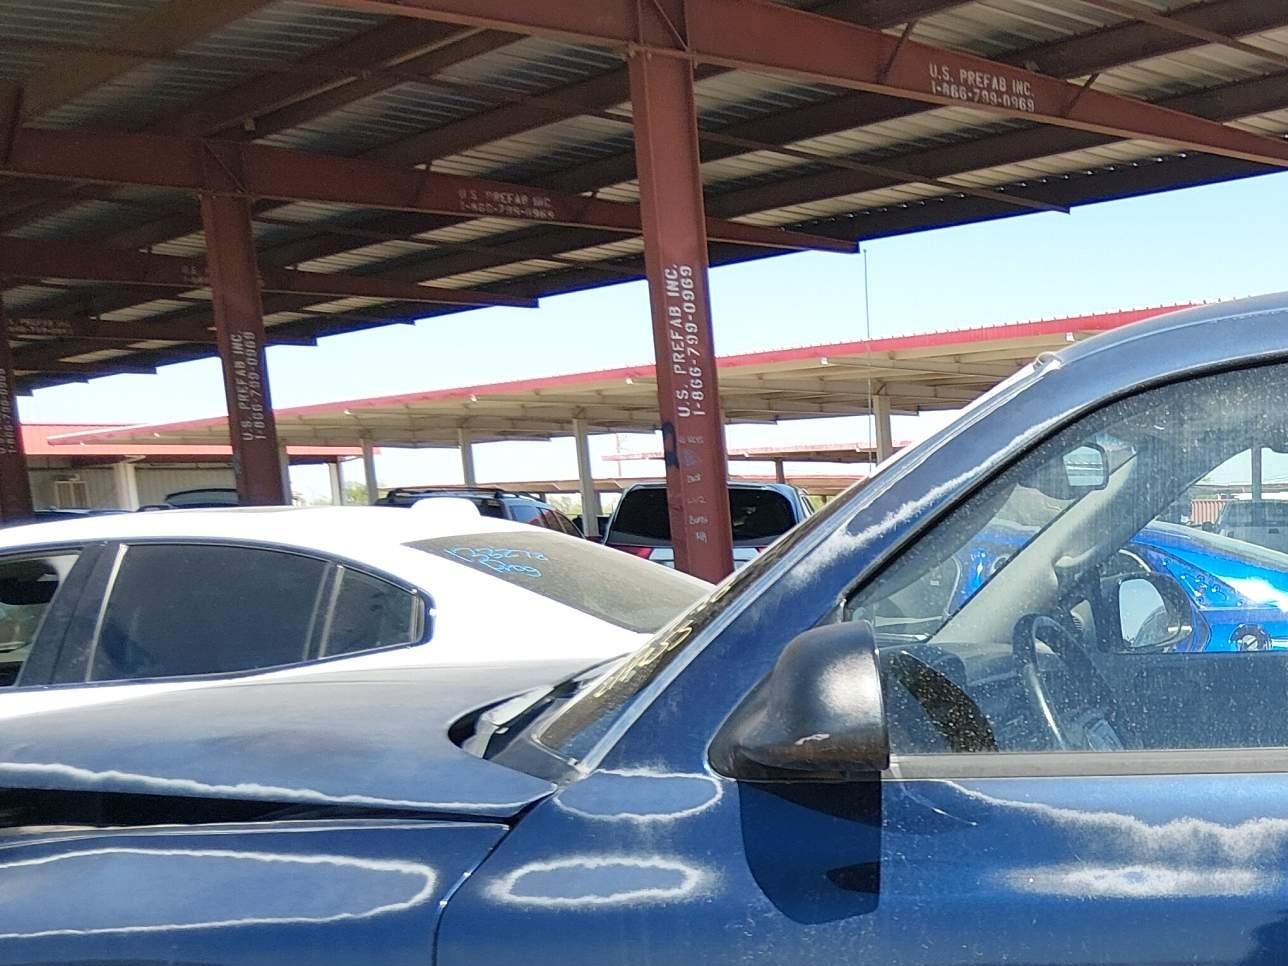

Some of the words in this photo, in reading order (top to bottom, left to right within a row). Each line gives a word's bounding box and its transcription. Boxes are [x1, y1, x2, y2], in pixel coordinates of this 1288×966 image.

[929, 63, 954, 82] U.S.
[959, 68, 1008, 92] PREFAB
[665, 263, 680, 297] INC.
[668, 306, 688, 375] PREFAB
[680, 265, 706, 415] 1-866-799-0969
[233, 361, 251, 410] PREFAB
[676, 384, 691, 417] U.S.
